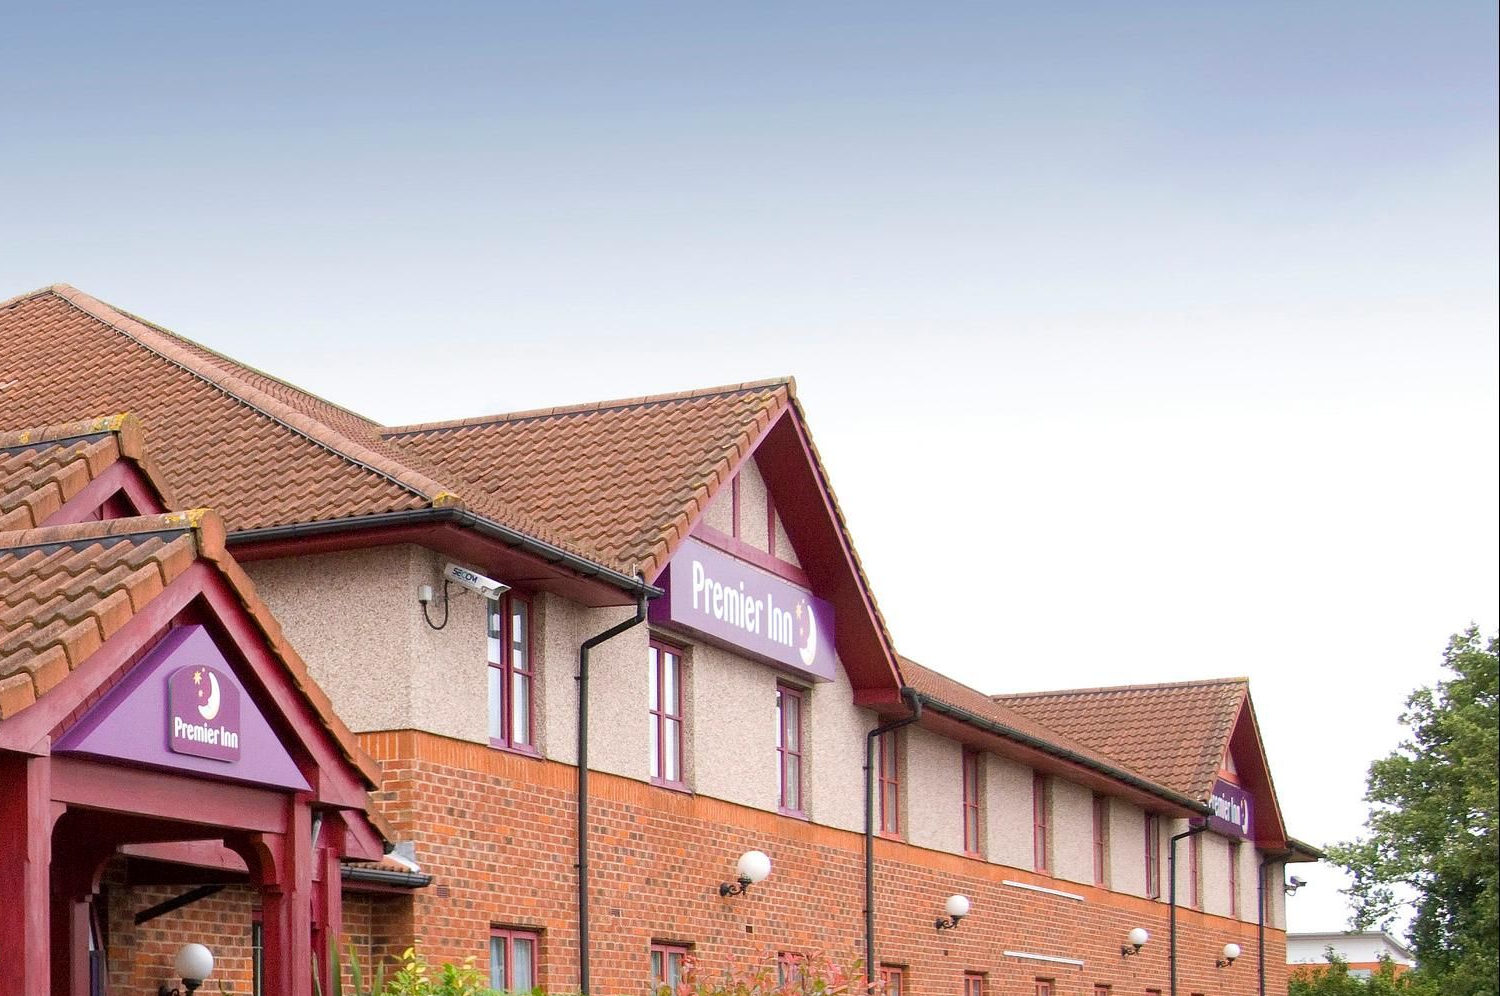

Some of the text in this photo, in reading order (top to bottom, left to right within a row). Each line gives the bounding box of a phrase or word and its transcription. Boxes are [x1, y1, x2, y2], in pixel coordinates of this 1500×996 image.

[452, 567, 478, 583] SECOM
[693, 560, 794, 648] Premier Inn
[174, 716, 239, 749] Premier Inn
